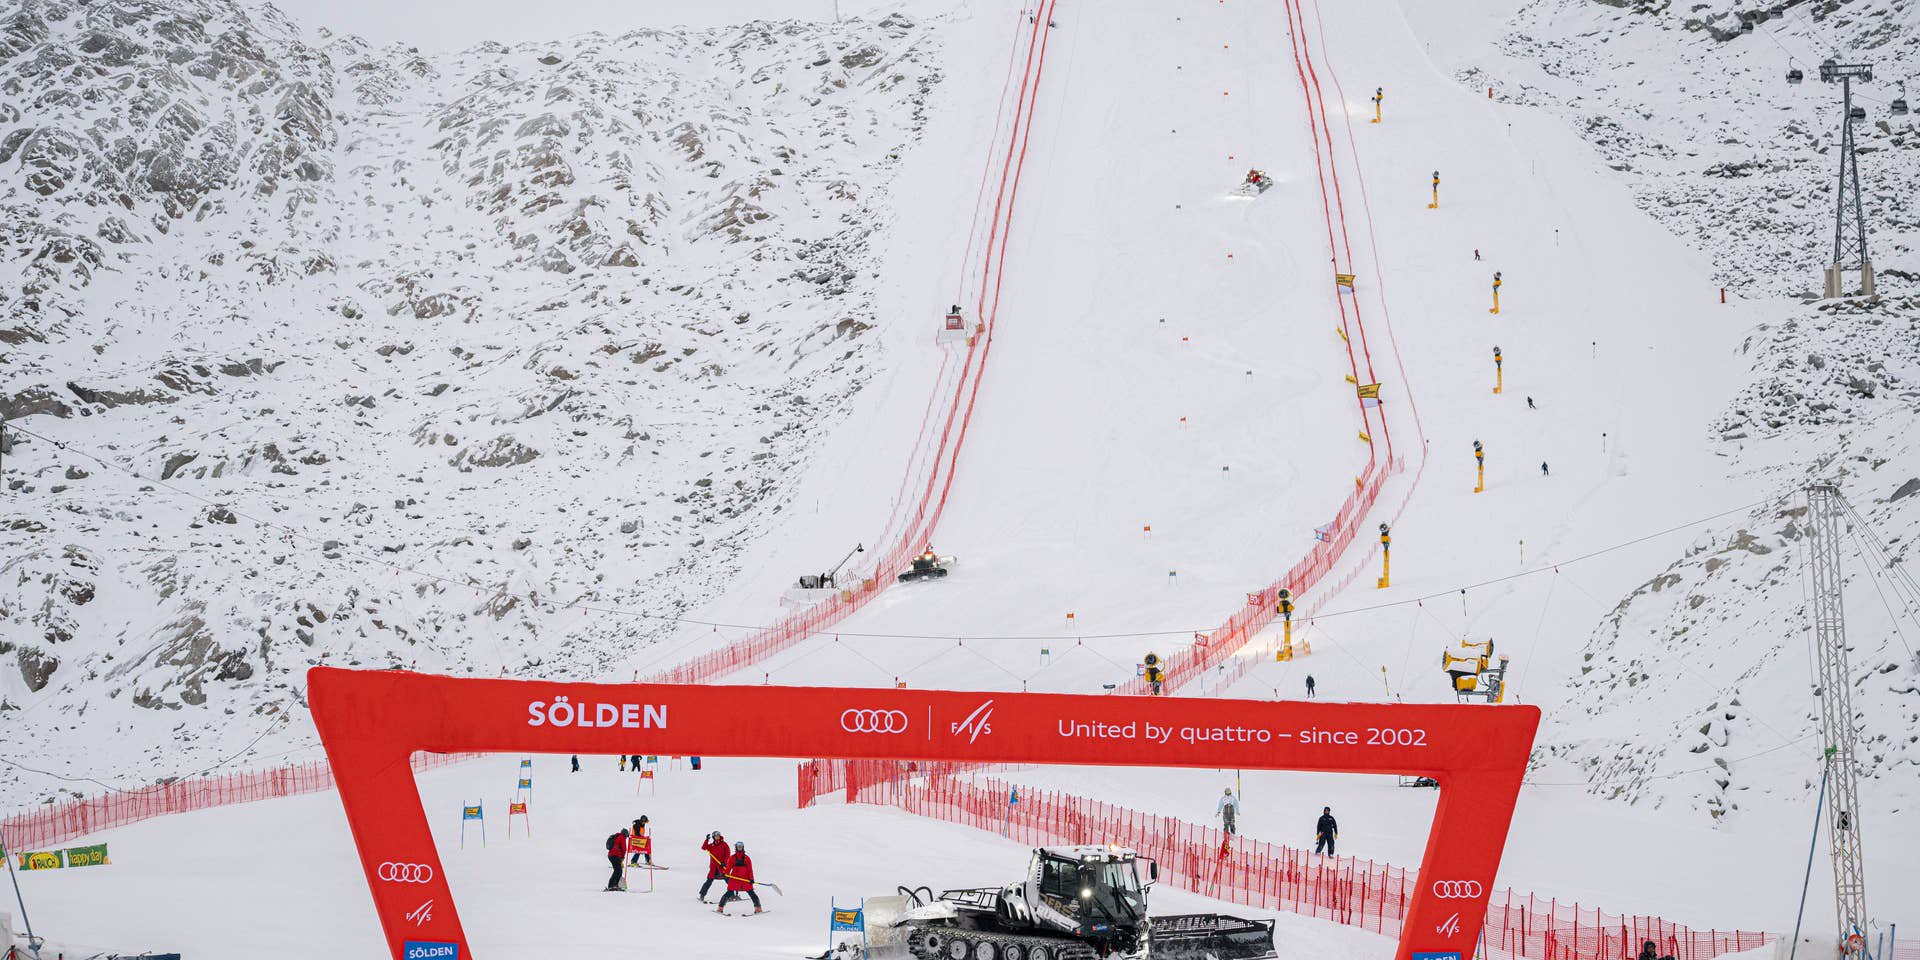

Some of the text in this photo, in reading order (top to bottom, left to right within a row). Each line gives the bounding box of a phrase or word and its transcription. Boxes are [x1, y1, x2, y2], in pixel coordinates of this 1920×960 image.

[527, 695, 667, 729] SÖLDEN
[1058, 719, 1136, 739] United
[1145, 722, 1173, 744] by
[1180, 725, 1271, 745] quattro
[1300, 727, 1358, 745] since
[1366, 728, 1427, 746] 2002
[409, 946, 453, 959] SÖLDEN
